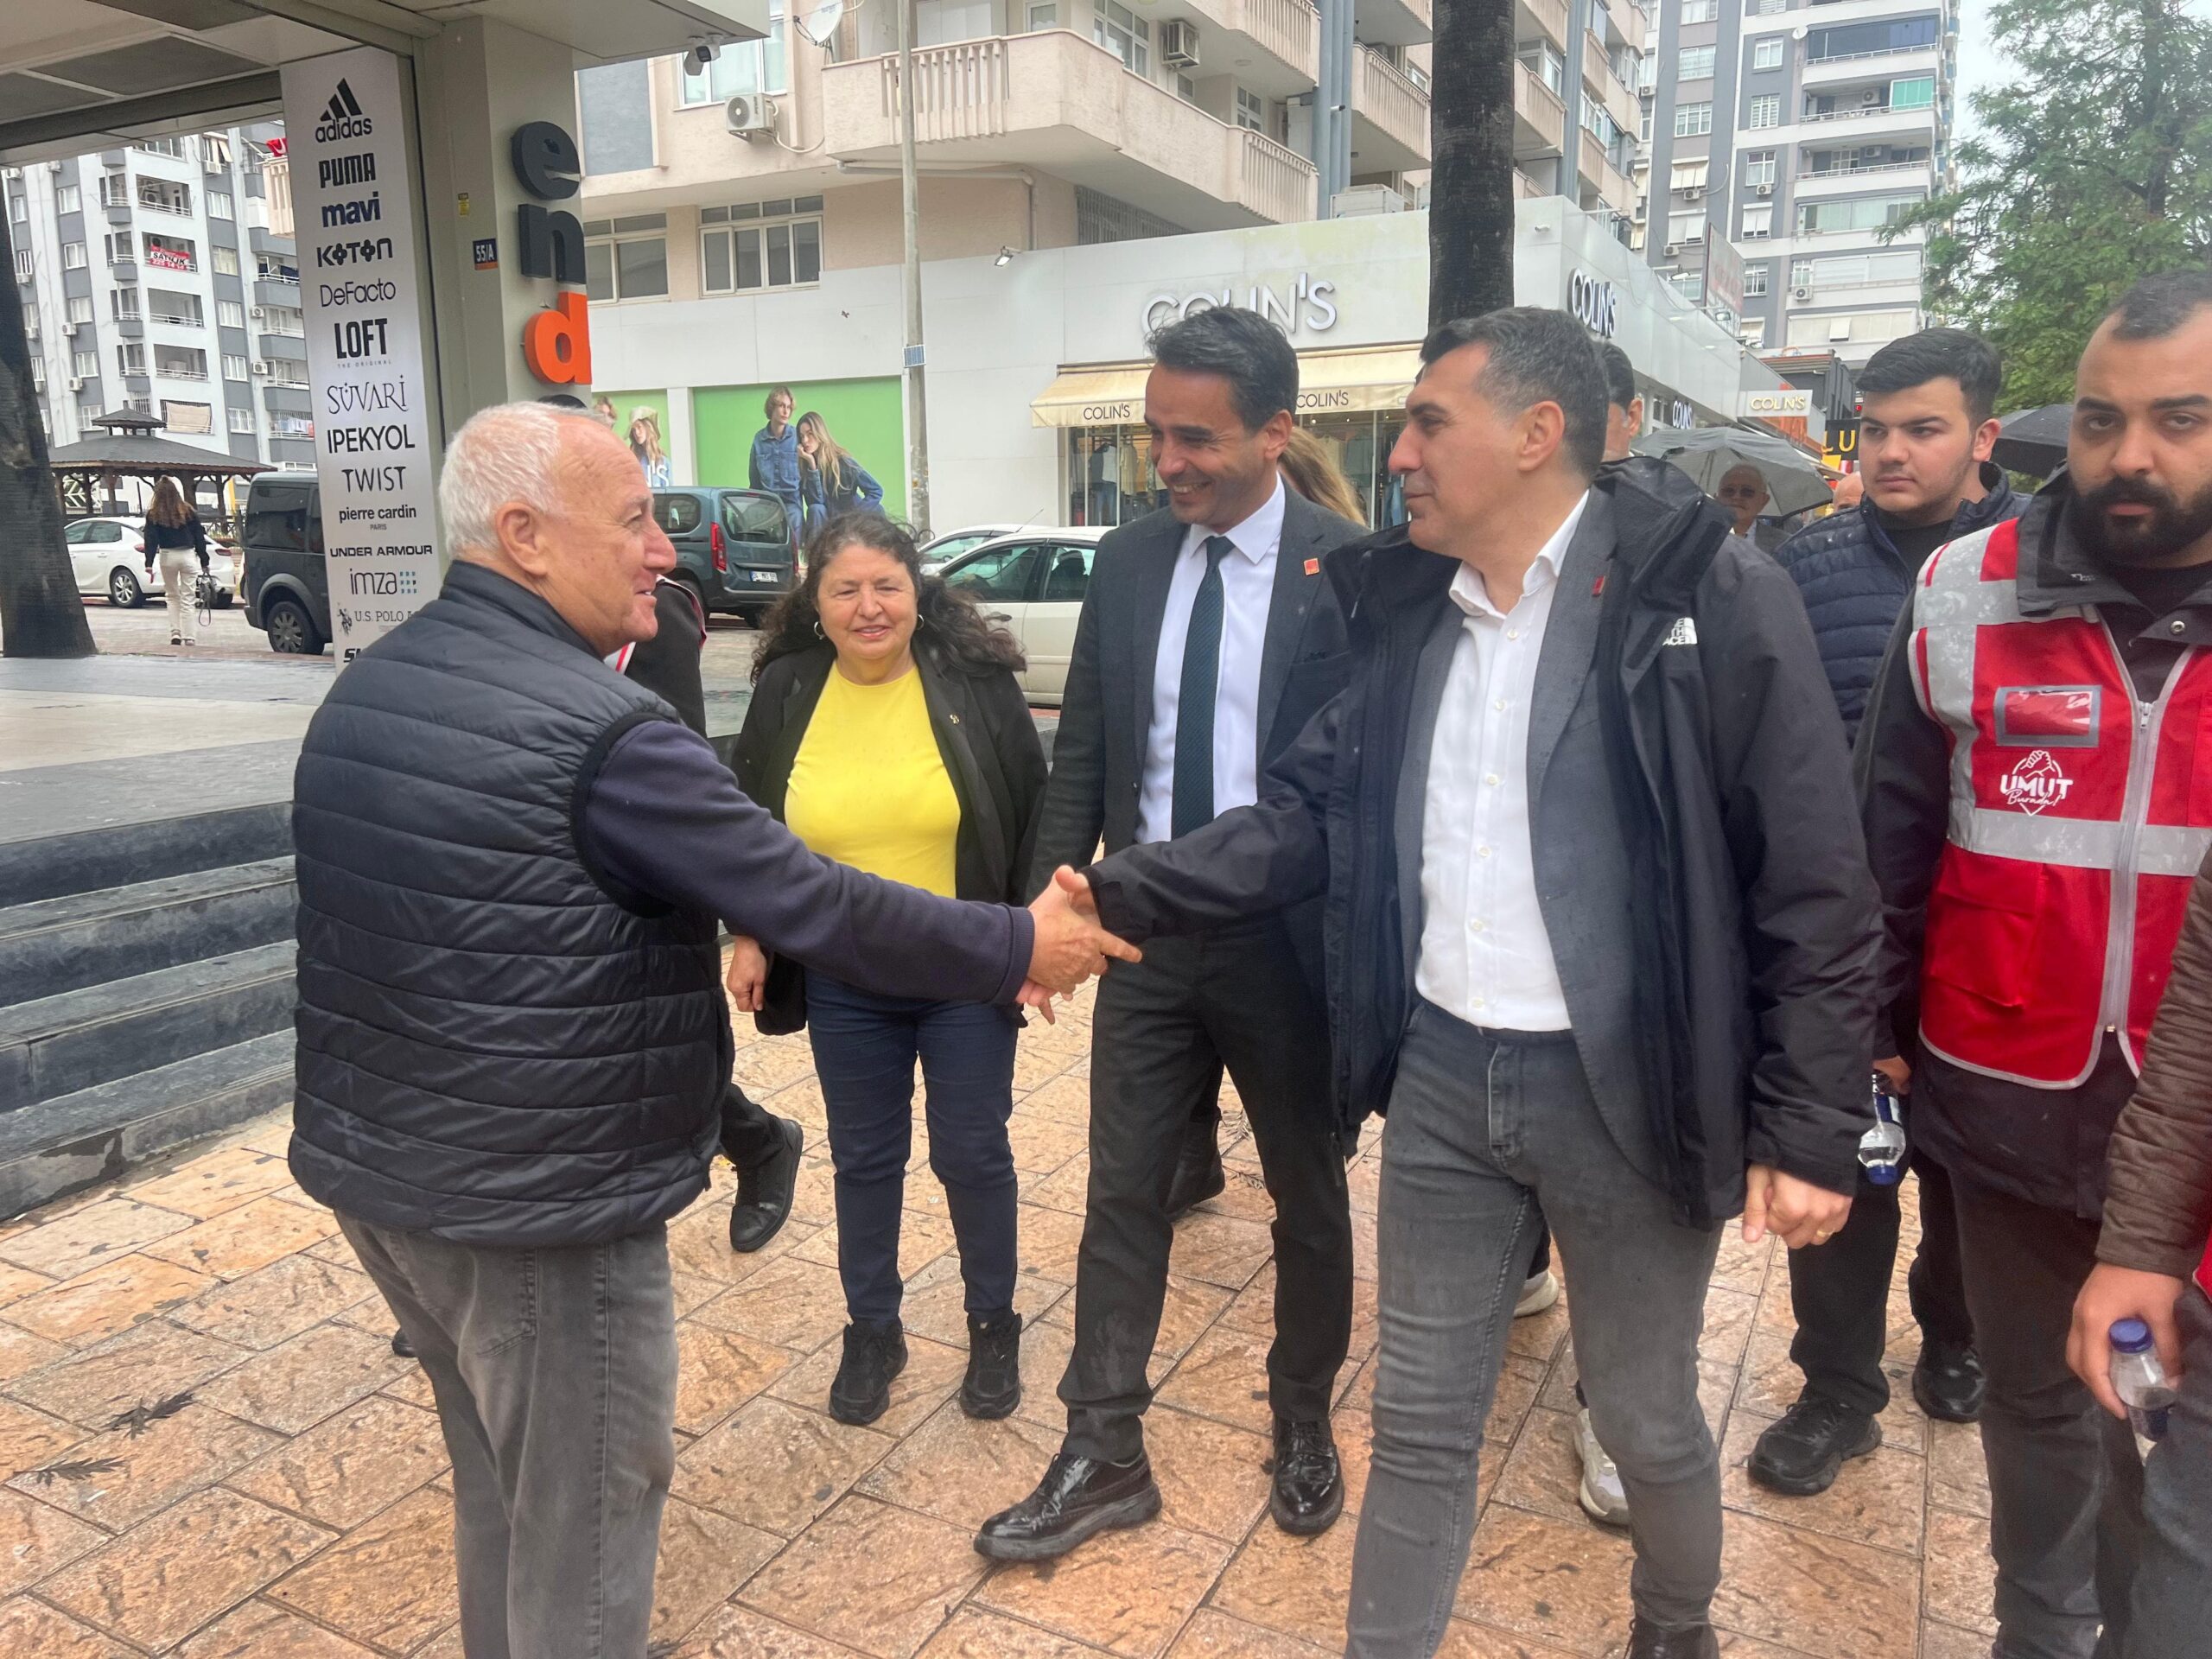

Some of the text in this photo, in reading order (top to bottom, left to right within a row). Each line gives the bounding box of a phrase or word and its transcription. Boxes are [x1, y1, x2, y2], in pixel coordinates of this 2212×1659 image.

[315, 117, 372, 143] adidas
[319, 153, 376, 188] PUMA
[321, 191, 381, 227] mavi
[317, 238, 393, 267] KOTON
[476, 244, 495, 263] 55/A
[320, 278, 396, 308] DeFacto
[1567, 268, 1616, 338] COLIN'S
[334, 318, 388, 359] LOFT
[1084, 403, 1130, 420] COLIN'S
[1296, 390, 1349, 408] COLIN'S
[327, 424, 416, 454] IPEKYOL
[341, 467, 407, 493] TWIST
[339, 505, 416, 524] pierre cardin
[330, 545, 433, 557] UNDER ARMOUR
[349, 569, 397, 594] imza
[376, 611, 404, 621] POLO
[1999, 774, 2074, 799] UMUT
